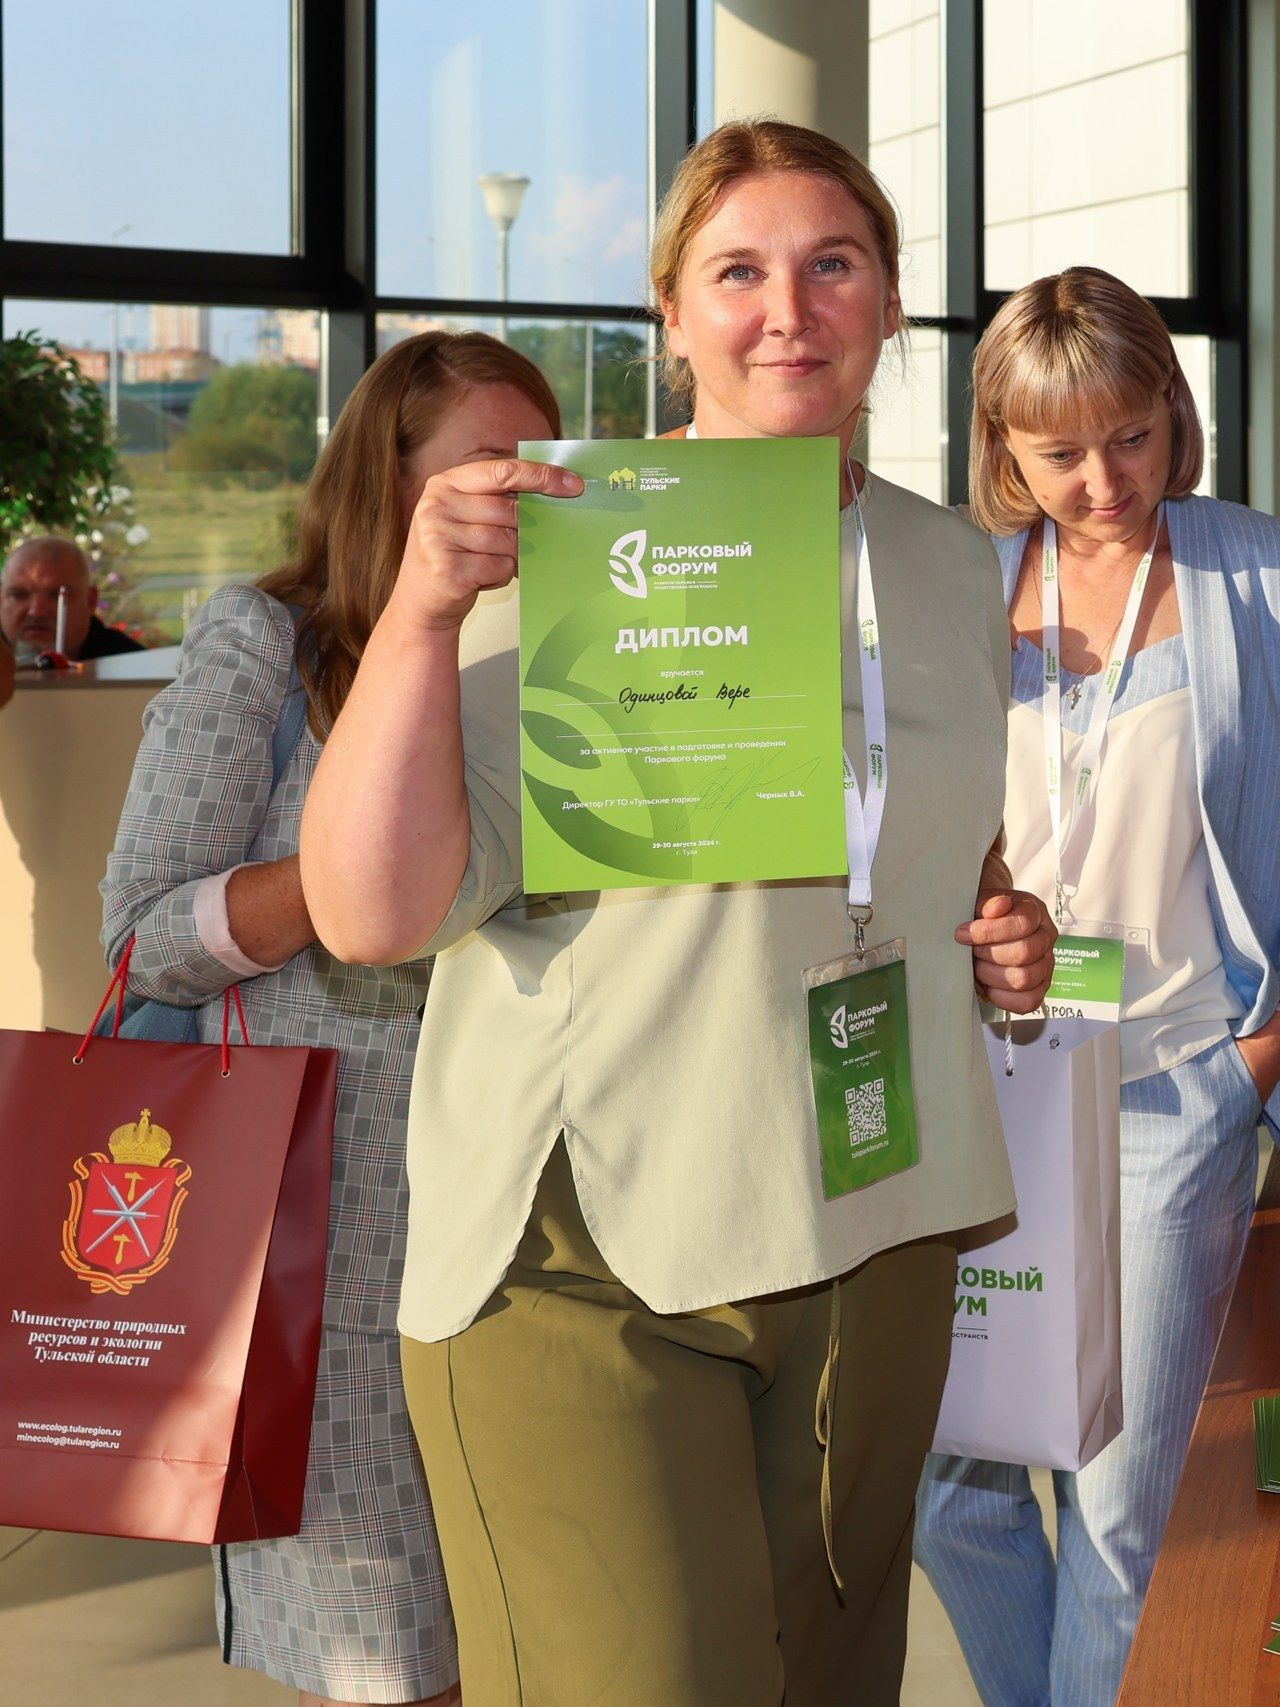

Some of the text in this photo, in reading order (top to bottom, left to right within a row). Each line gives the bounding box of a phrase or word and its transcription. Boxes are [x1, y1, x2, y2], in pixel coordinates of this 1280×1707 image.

[640, 477, 681, 485] ТУЛЬСКИЕ
[652, 541, 752, 560] ПАРКОВЫЙ
[652, 562, 718, 577] ФОРУМ
[615, 625, 749, 654] ДИПЛОМ
[660, 669, 704, 679] вручается
[619, 683, 750, 713] Одинцовой Вере
[592, 747, 633, 755] активное
[634, 745, 669, 754] участие
[677, 743, 726, 752] подготовке
[735, 740, 786, 749] проведении
[645, 754, 726, 765] Паркового форума
[876, 754, 884, 789] ПАРКОВЫЙ
[562, 800, 604, 811] Директор
[605, 799, 615, 807] ГУ
[629, 797, 670, 807] «Тульские
[756, 791, 788, 800] Черных
[789, 790, 805, 799] В.А.
[673, 840, 697, 849] августа
[698, 839, 715, 847] 2024
[683, 849, 698, 857] Тула
[1052, 948, 1100, 959] ПАРКОВЫЙ
[847, 1001, 888, 1022] ПАРКОВЫЙ
[848, 1017, 876, 1033] ФОРУМ
[955, 1266, 1043, 1292] ОВЫЙ
[11, 1309, 188, 1336] Министерство природных
[28, 1331, 163, 1351] ресурсов и экологии
[34, 1346, 150, 1367] Тульской области
[18, 1420, 122, 1437] www.ecolog.tularegion.ru
[16, 1433, 120, 1449] minecolog@tularegion.ru
